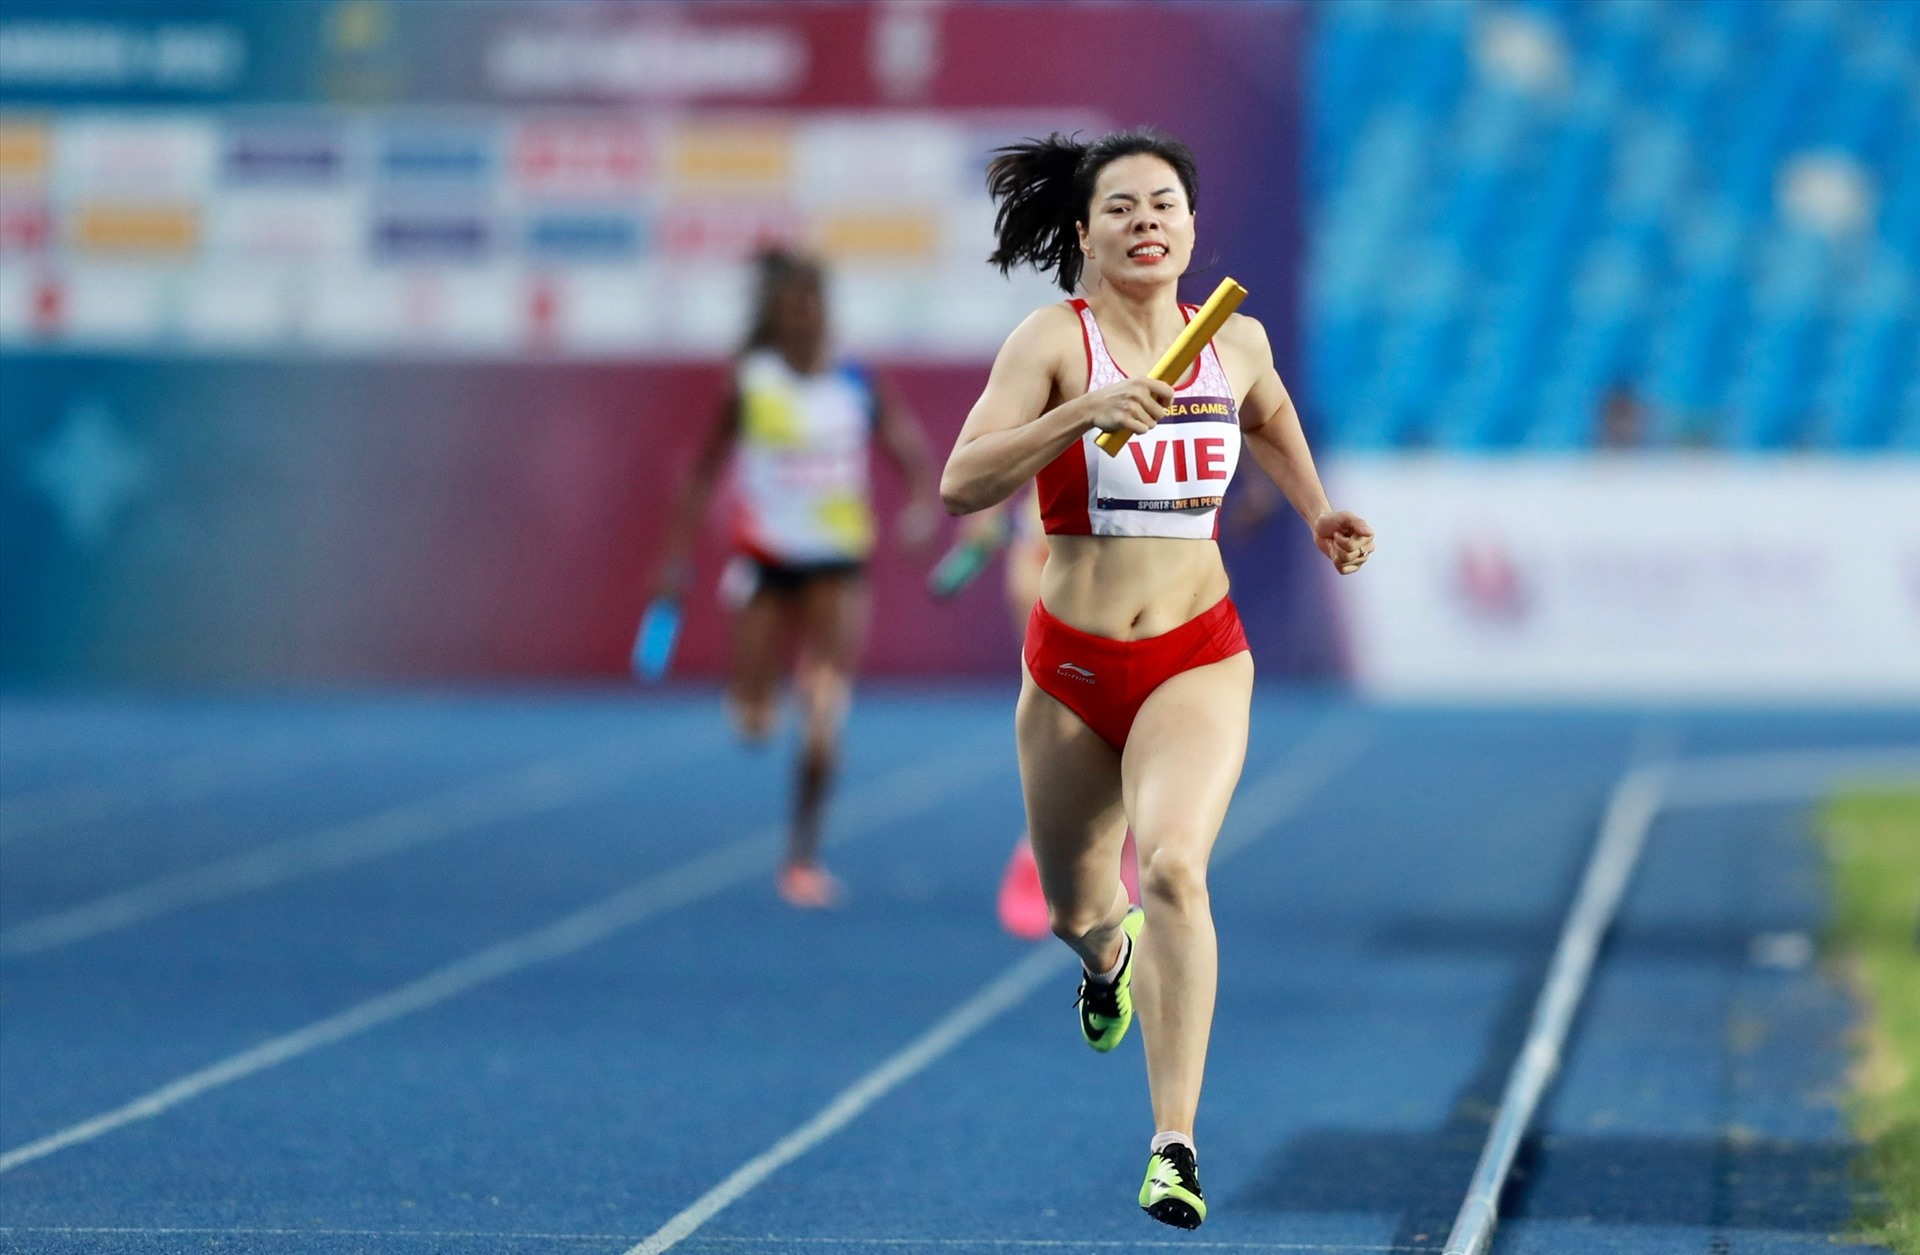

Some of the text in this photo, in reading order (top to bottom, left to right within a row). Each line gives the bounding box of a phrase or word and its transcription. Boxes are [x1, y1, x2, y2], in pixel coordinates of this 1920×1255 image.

[1190, 403, 1229, 416] GAMES
[1127, 438, 1227, 484] VIE
[1190, 499, 1199, 508] IN
